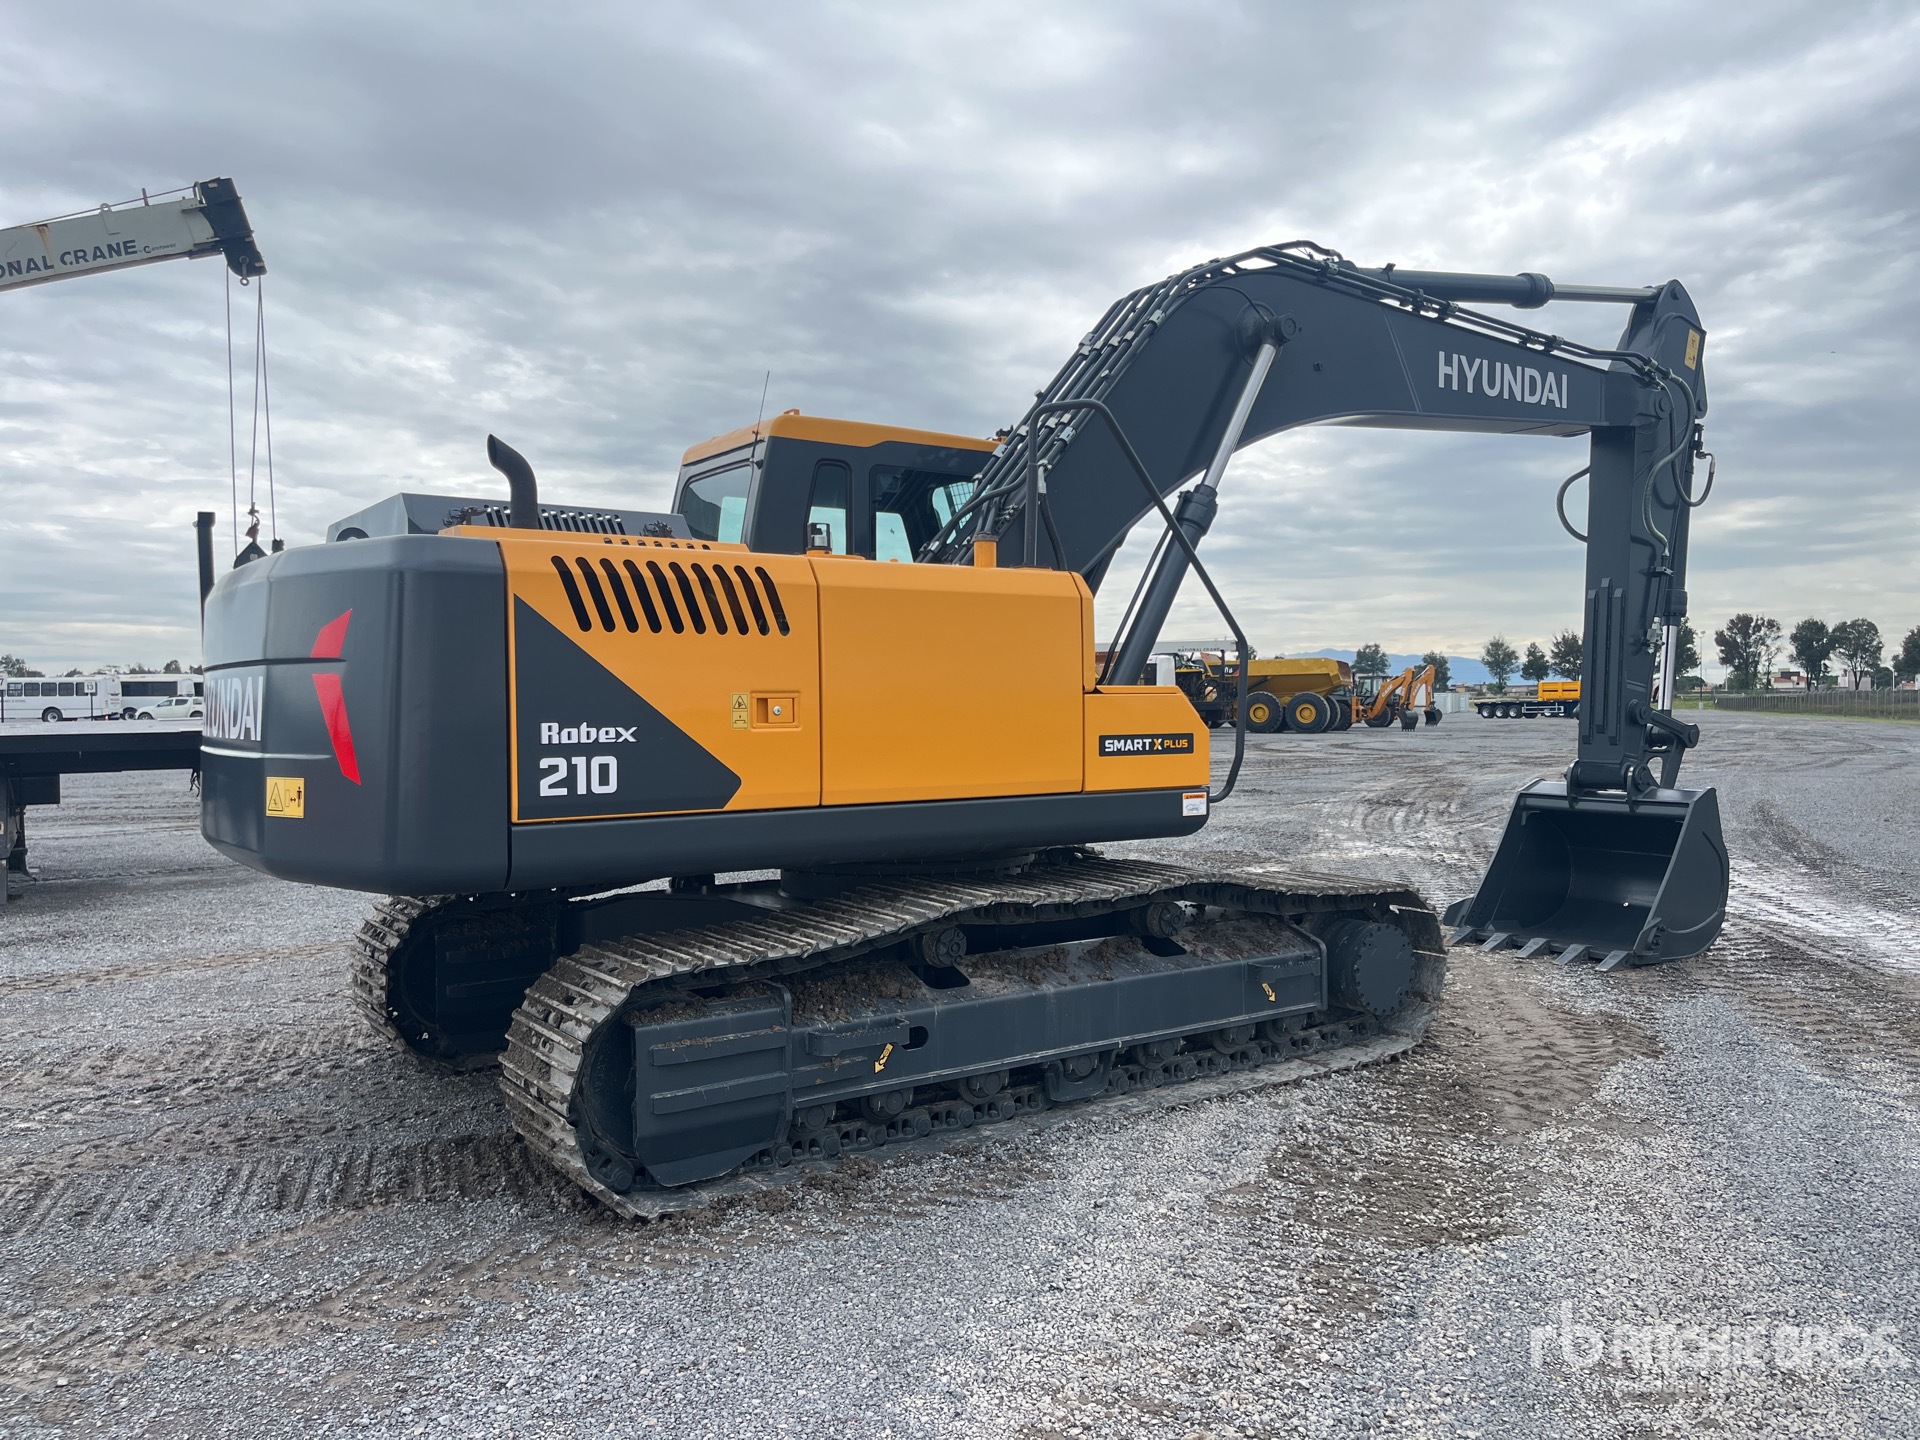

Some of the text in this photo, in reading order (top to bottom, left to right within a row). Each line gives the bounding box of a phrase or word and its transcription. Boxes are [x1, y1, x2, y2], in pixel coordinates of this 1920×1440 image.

[60, 240, 137, 265] CRANE
[1438, 351, 1568, 409] HYUNDAI
[540, 722, 638, 744] Robex
[1104, 738, 1188, 752] SMART X PLUS
[539, 756, 618, 797] 210
